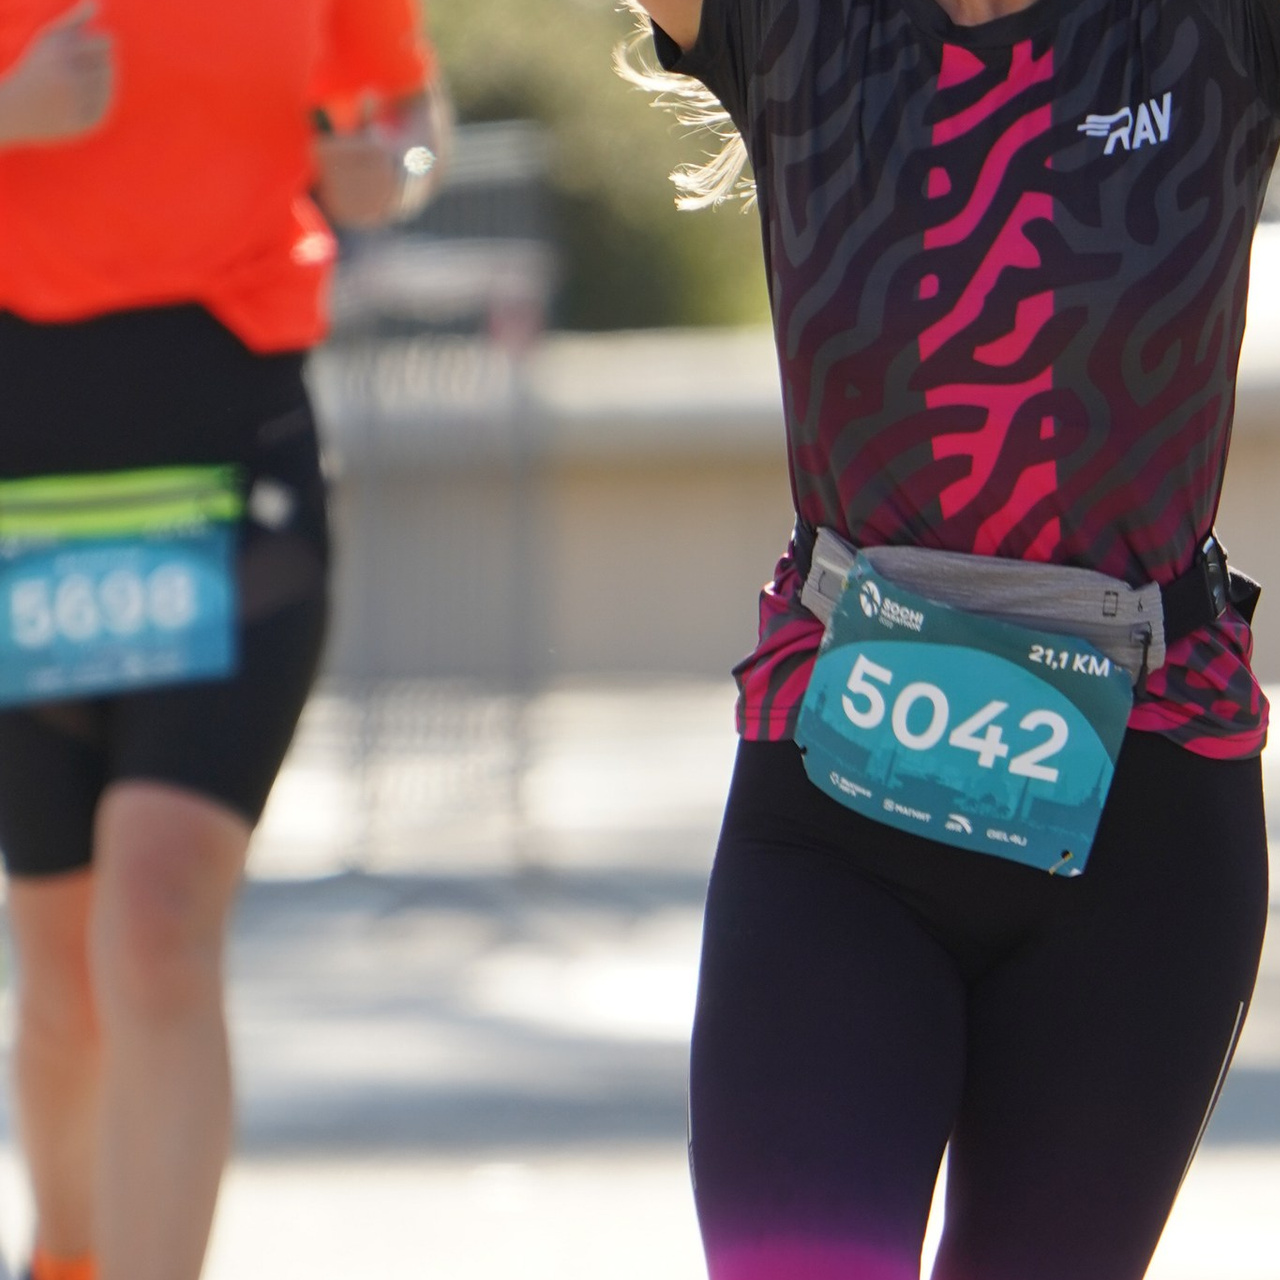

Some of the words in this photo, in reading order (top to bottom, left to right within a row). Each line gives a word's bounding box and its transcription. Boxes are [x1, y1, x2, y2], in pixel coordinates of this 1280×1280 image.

[1080, 92, 1172, 154] RAY
[881, 597, 924, 625] SOCHI
[1028, 644, 1069, 670] 21,1
[1072, 653, 1110, 677] KM
[841, 653, 1069, 783] 5042
